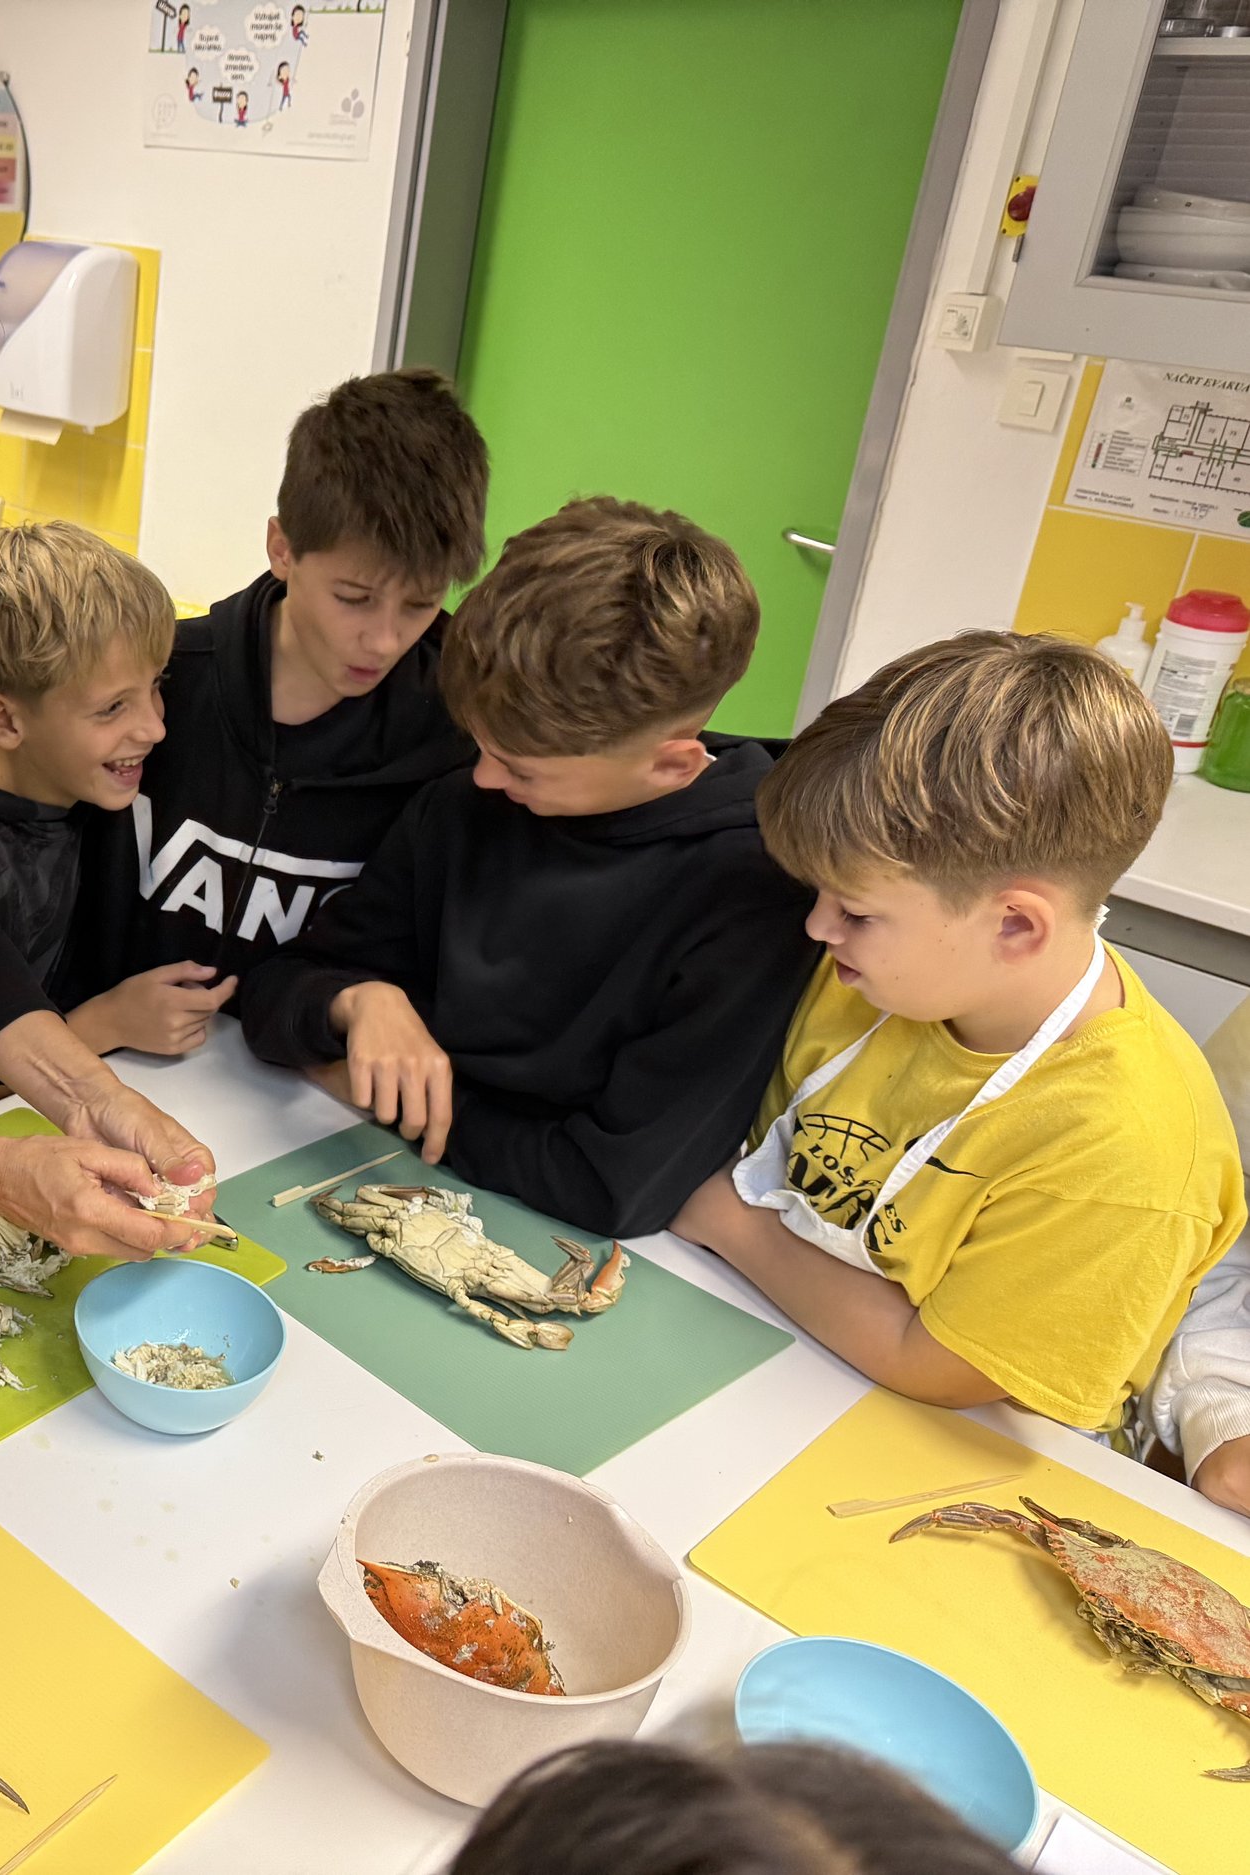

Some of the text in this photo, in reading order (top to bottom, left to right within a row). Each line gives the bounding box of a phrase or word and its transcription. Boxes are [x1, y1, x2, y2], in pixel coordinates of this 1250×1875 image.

[1162, 371, 1204, 386] NAČRT
[132, 793, 365, 945] VAN
[808, 1143, 856, 1188] LOS
